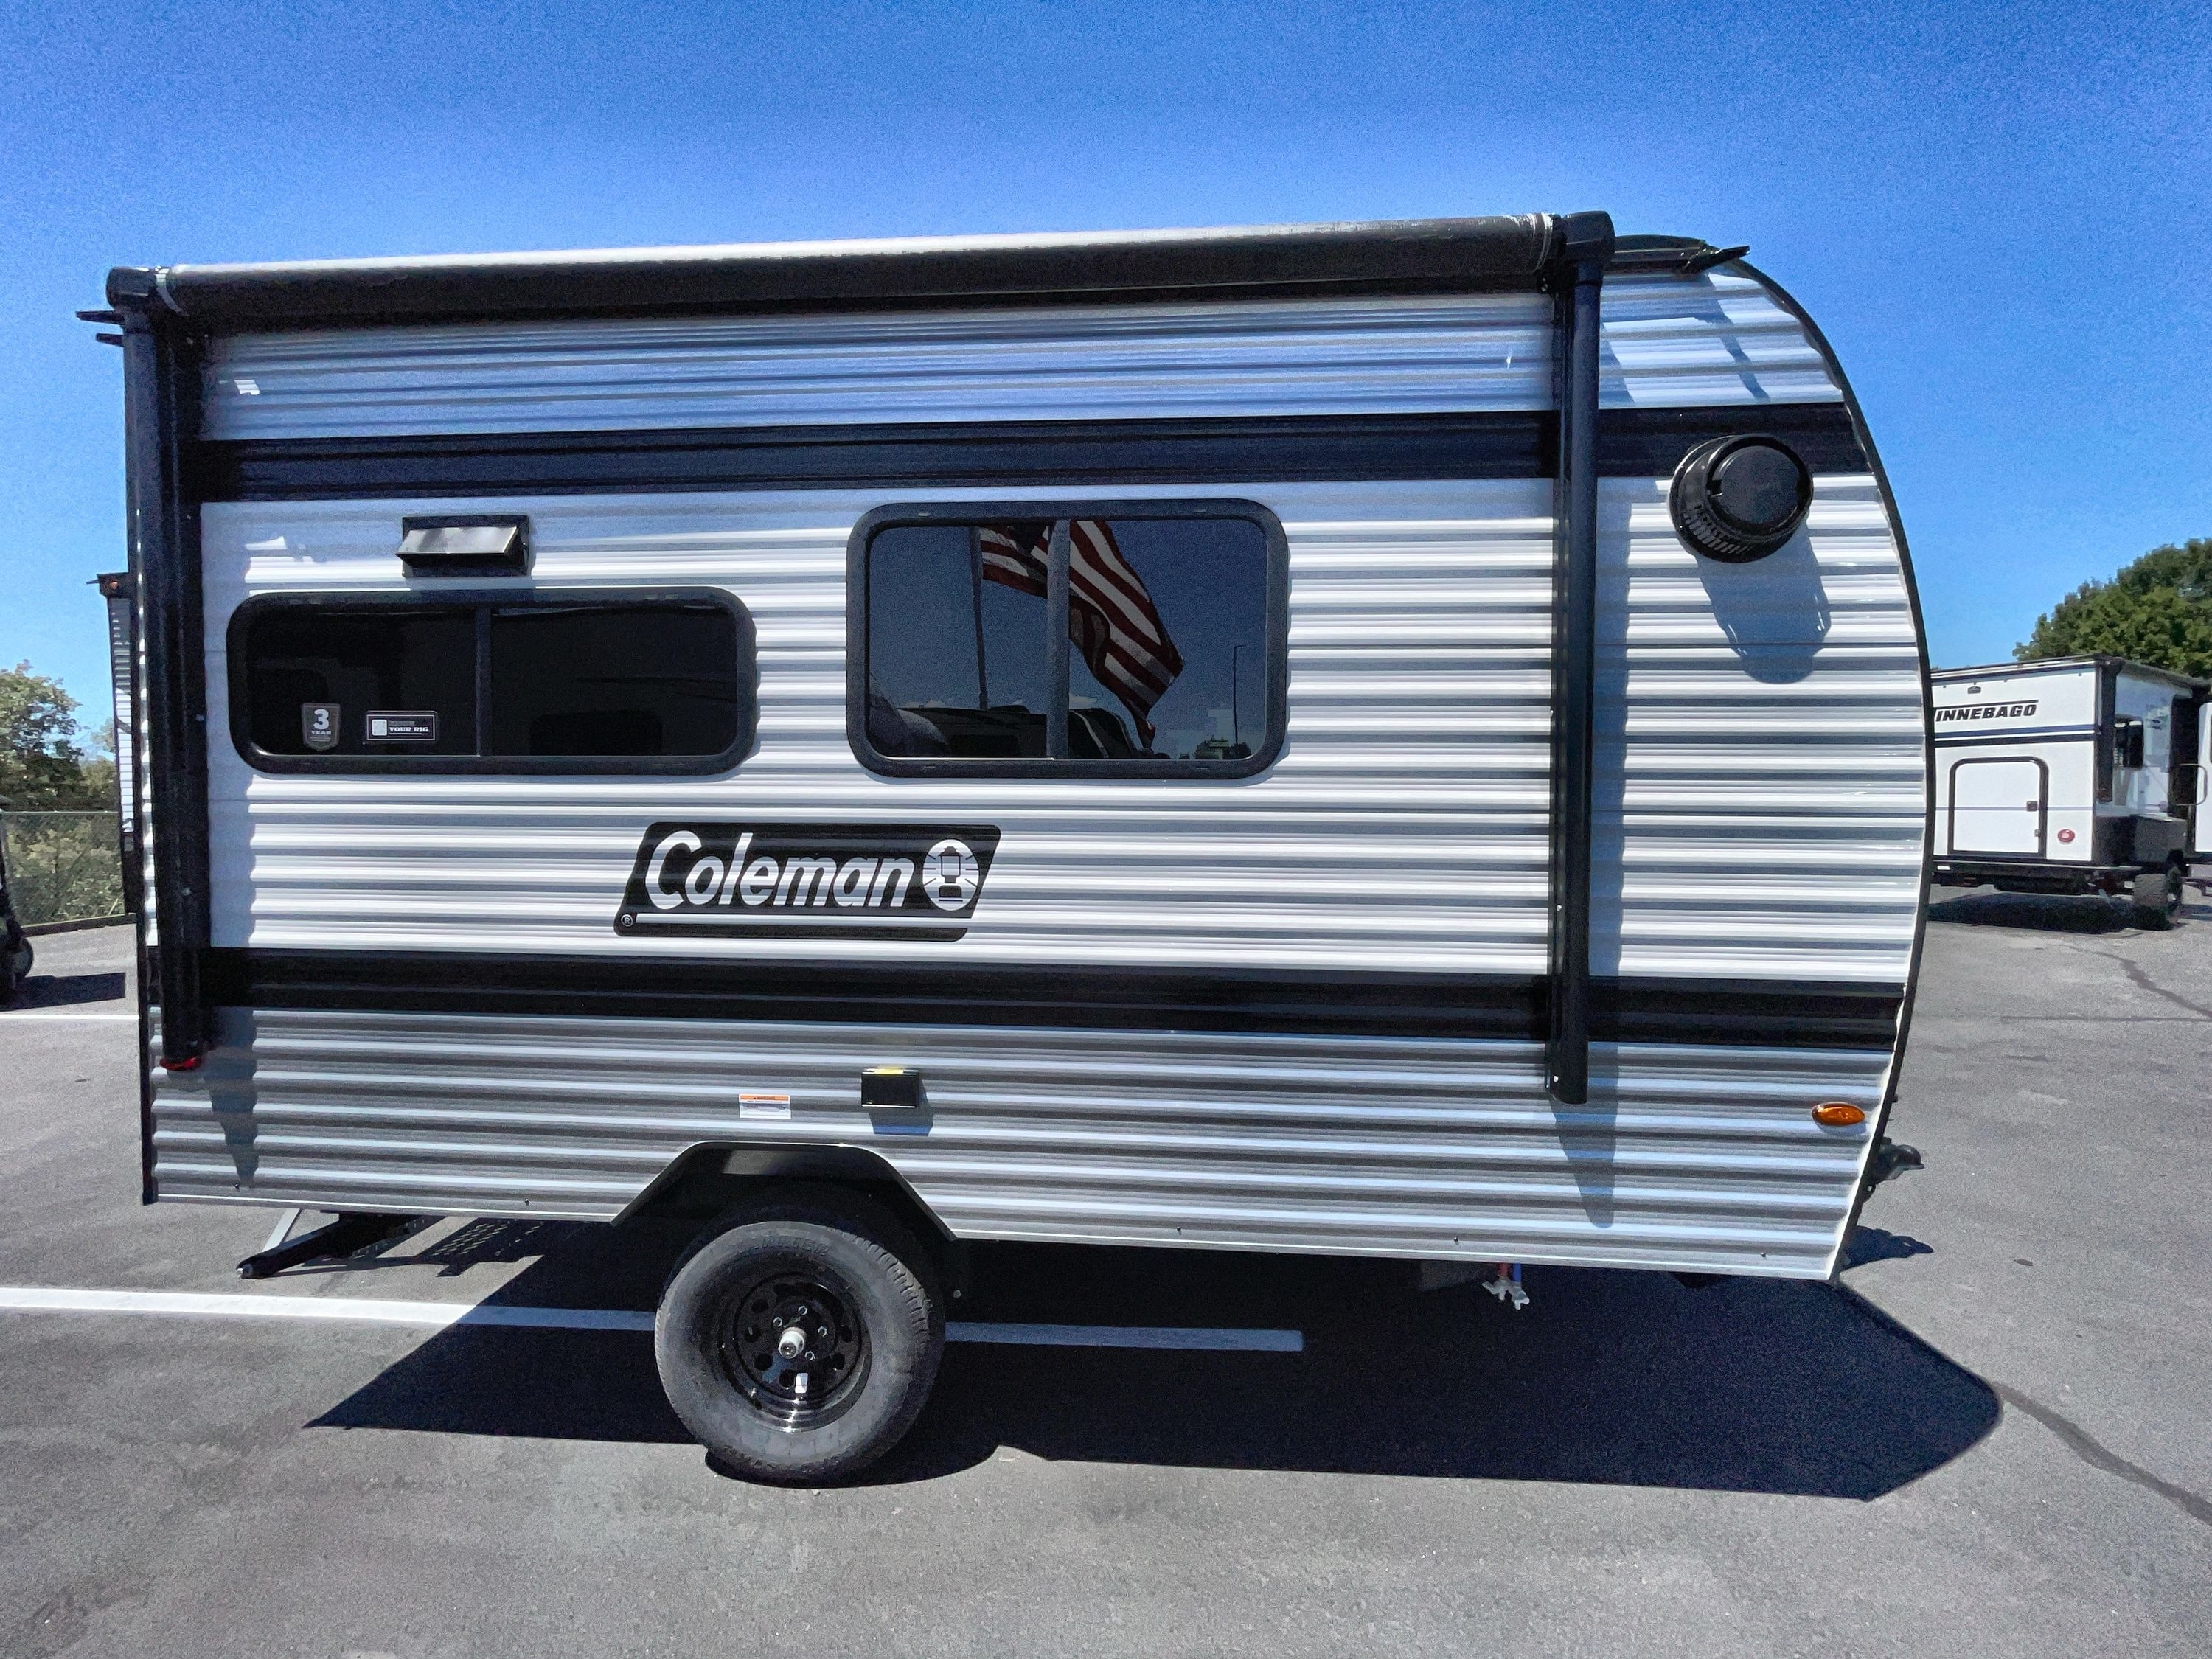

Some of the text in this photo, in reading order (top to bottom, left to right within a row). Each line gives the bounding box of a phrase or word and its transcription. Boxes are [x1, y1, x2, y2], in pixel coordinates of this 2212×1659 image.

[313, 709, 330, 730] 3
[1933, 704, 2037, 722] INNEBAGO
[645, 830, 915, 910] Coleman
